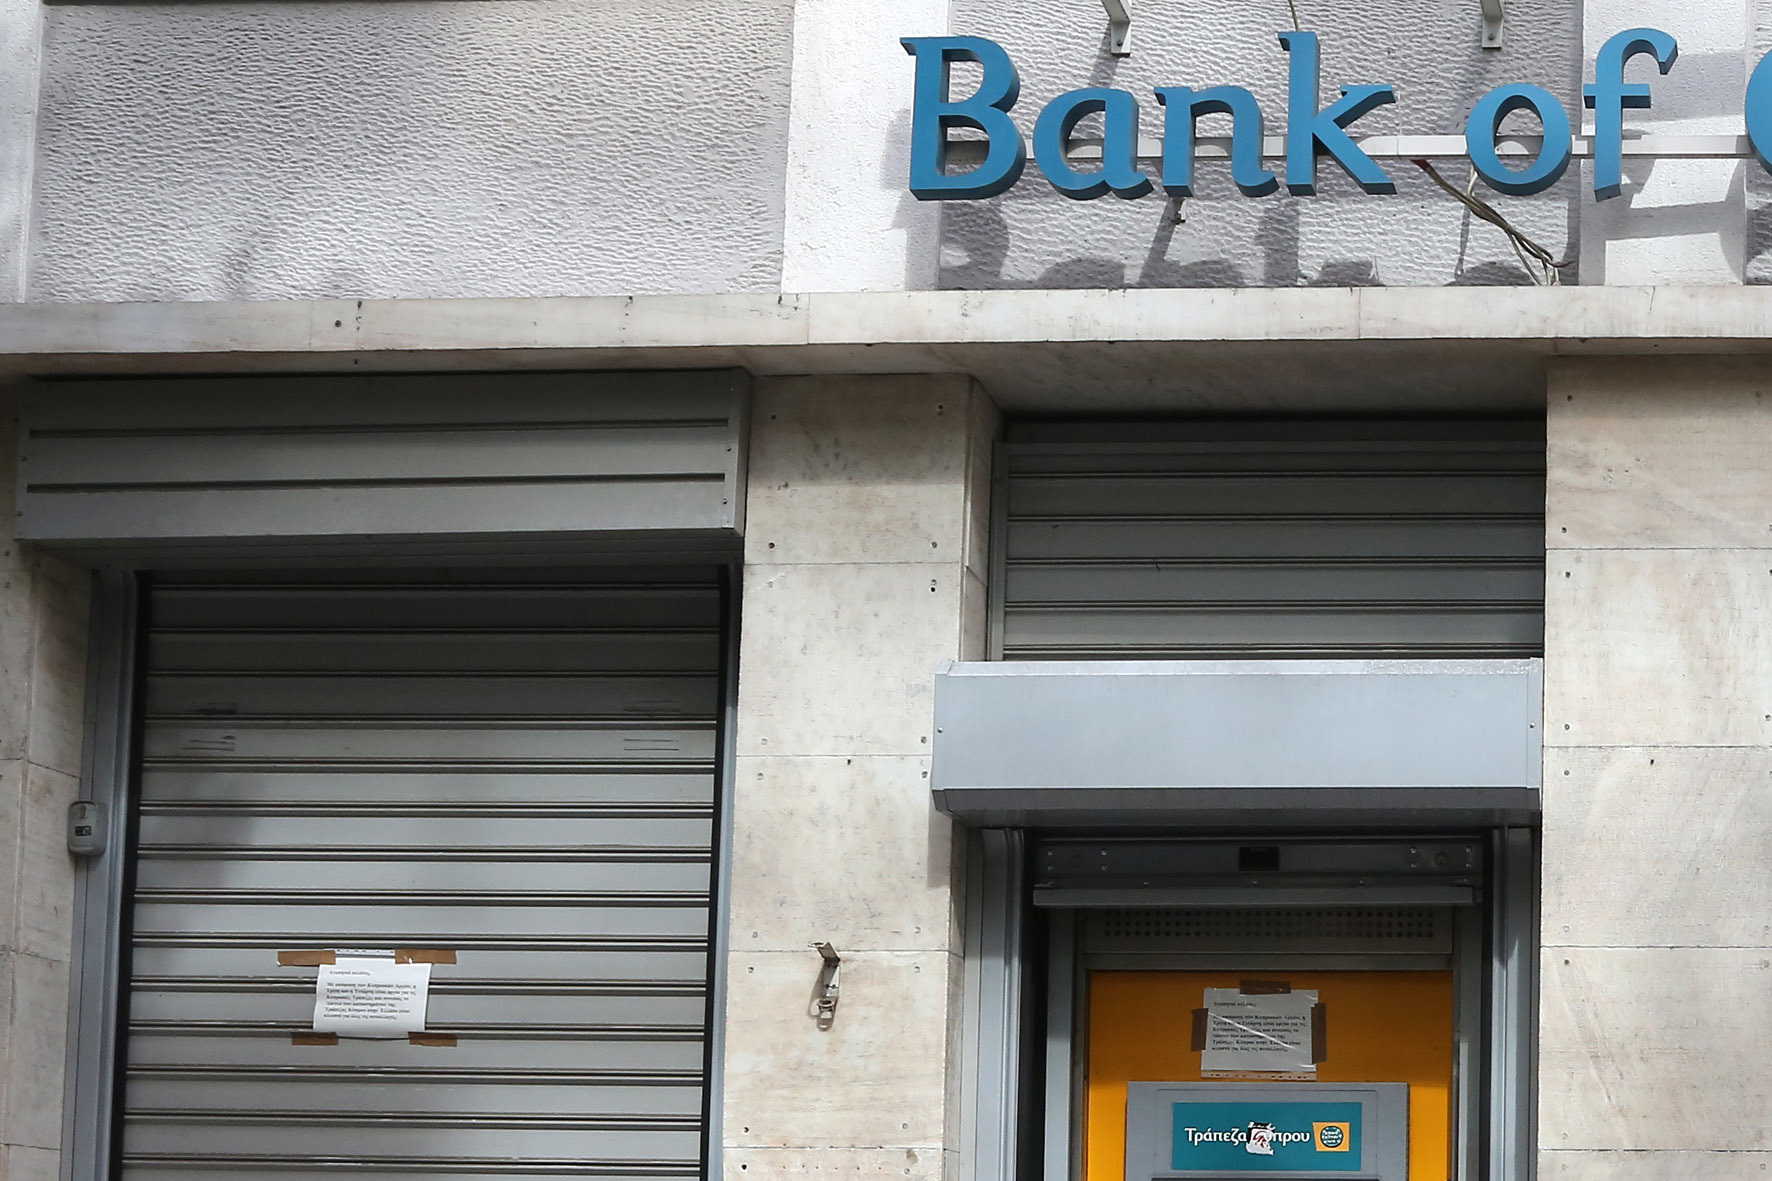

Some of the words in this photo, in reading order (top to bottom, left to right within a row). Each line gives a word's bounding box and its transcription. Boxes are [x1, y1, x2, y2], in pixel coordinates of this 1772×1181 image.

[899, 30, 1397, 200] Bank
[1465, 28, 1679, 201] of
[1184, 1127, 1247, 1146] Τράπεζα
[1252, 1131, 1310, 1146] πρου
